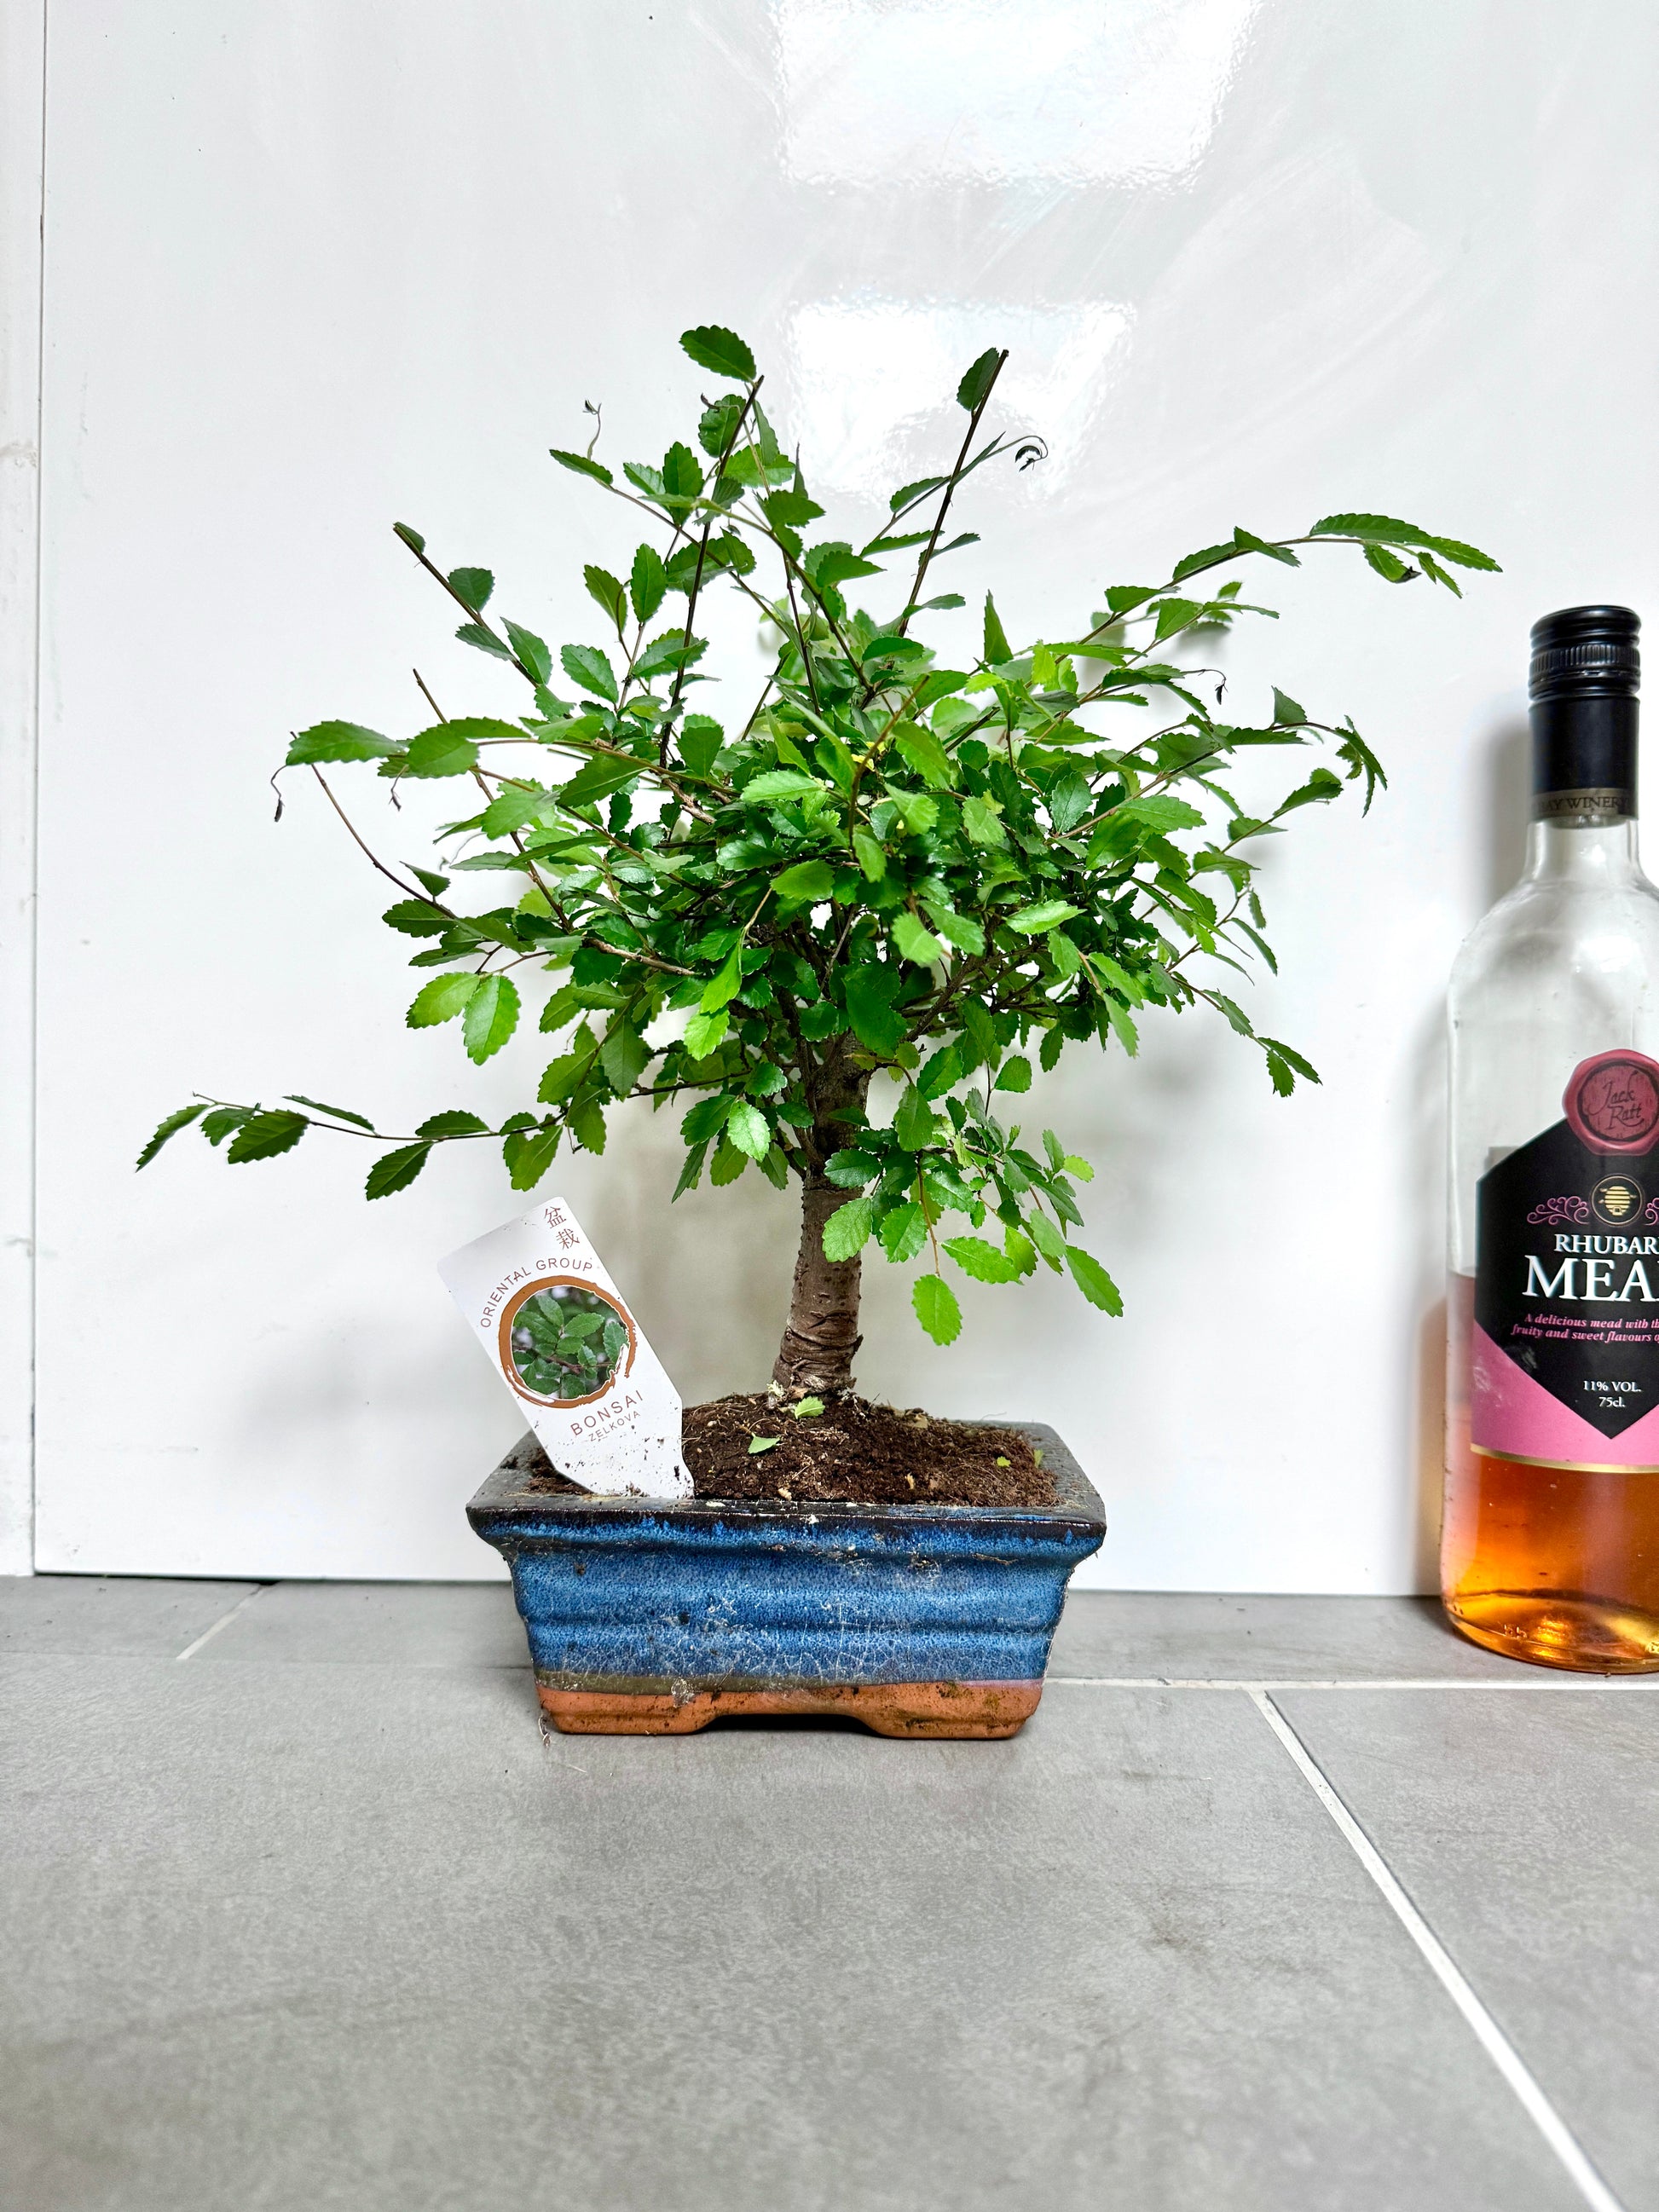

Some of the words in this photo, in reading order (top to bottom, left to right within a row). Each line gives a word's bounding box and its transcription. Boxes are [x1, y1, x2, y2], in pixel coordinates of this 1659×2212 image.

[1587, 1070, 1639, 1116] Jack
[544, 1206, 581, 1250] 盆栽
[1554, 1233, 1659, 1256] RHUBAR
[480, 1266, 532, 1328] ORIENTAL
[535, 1257, 593, 1273] GROUP
[1522, 1255, 1659, 1302] MEA
[1511, 1323, 1543, 1339] fruity
[1545, 1328, 1569, 1340] and
[1571, 1331, 1604, 1342] sweet
[1604, 1331, 1652, 1344] flavours
[1524, 1313, 1532, 1323] A
[1534, 1313, 1587, 1328] delicious
[1590, 1318, 1622, 1329] mead
[1625, 1319, 1649, 1329] with
[1583, 1380, 1609, 1392] 11%
[1611, 1381, 1642, 1393] VOL.
[1598, 1396, 1626, 1408] 75cl.
[569, 1389, 644, 1436] BONSAI
[587, 1410, 641, 1442] ZELKOVA
